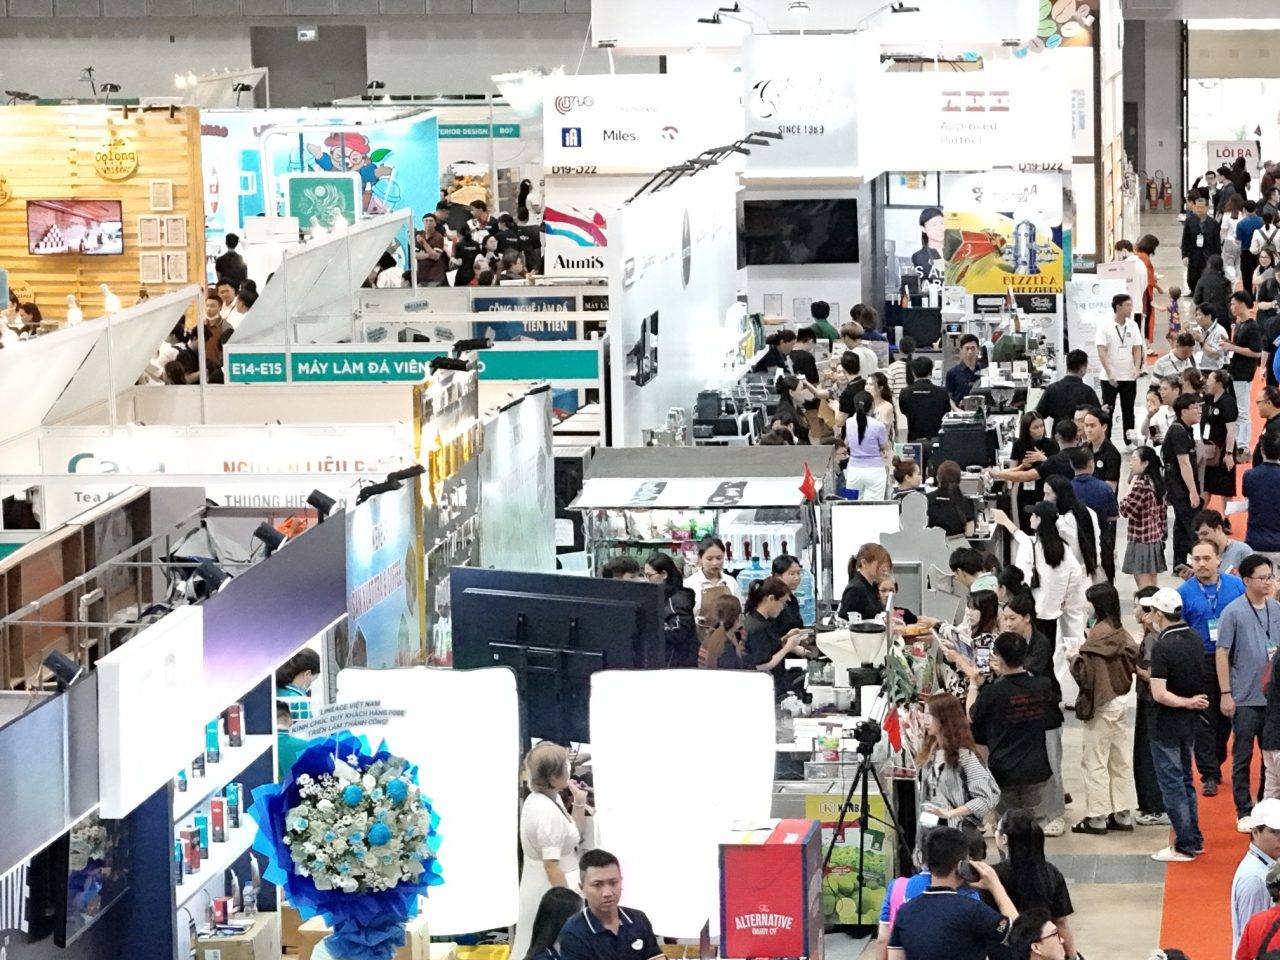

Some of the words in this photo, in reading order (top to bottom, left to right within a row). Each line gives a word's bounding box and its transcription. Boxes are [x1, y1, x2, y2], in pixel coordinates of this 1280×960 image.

[777, 124, 801, 134] SINCE
[1002, 275, 1057, 285] BEZZERA
[232, 362, 282, 375] E14-E15
[298, 359, 329, 375] MÁY
[333, 359, 363, 374] LÀM
[367, 358, 390, 374] ĐÁ
[392, 359, 428, 374] VIÊN
[74, 491, 102, 504] Tea
[734, 913, 794, 930] ALTERNATIVE
